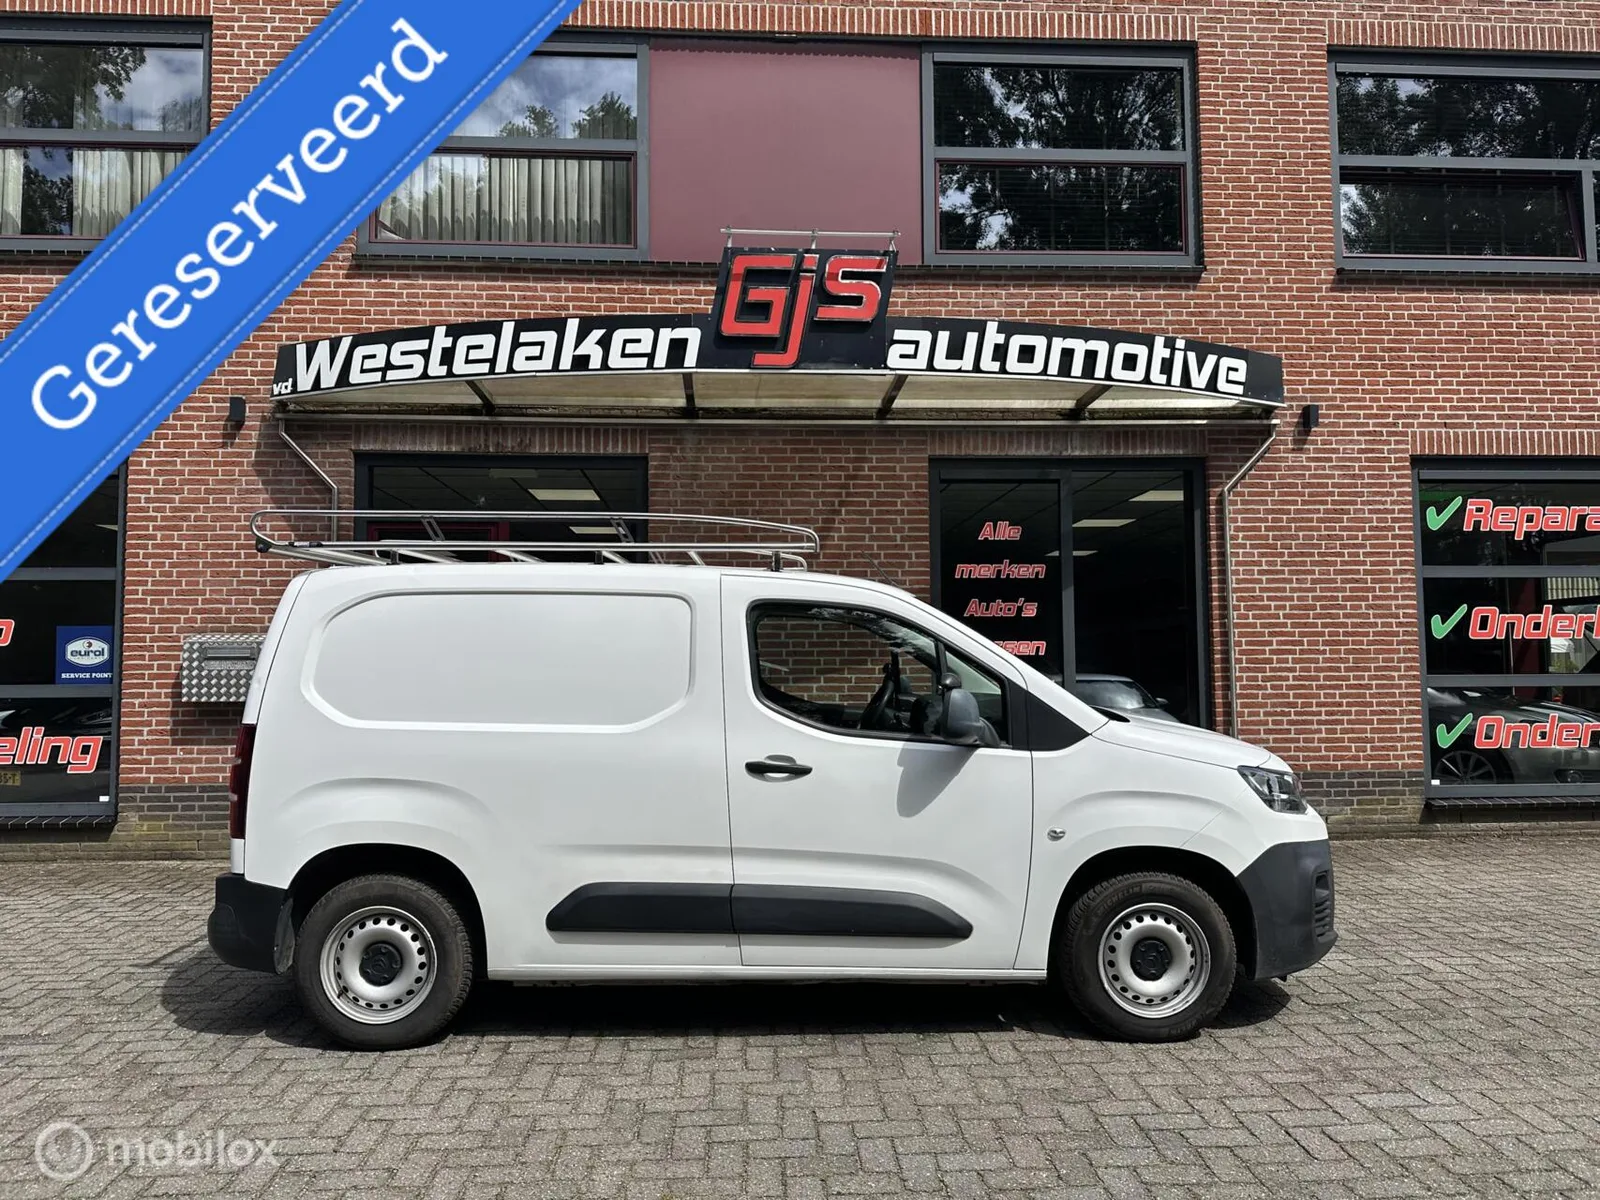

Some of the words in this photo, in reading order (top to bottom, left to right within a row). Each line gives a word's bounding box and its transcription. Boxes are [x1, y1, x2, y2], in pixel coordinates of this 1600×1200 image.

[272, 377, 293, 395] vd
[296, 318, 701, 391] Westelaken
[886, 321, 1248, 395] automotive
[978, 521, 1022, 540] Alle
[955, 560, 1046, 578] merken
[964, 598, 1038, 617] Auto's
[1469, 604, 1600, 640] Onder
[70, 647, 105, 657] eurol
[994, 640, 1047, 656] sen
[1474, 713, 1600, 748] Onder
